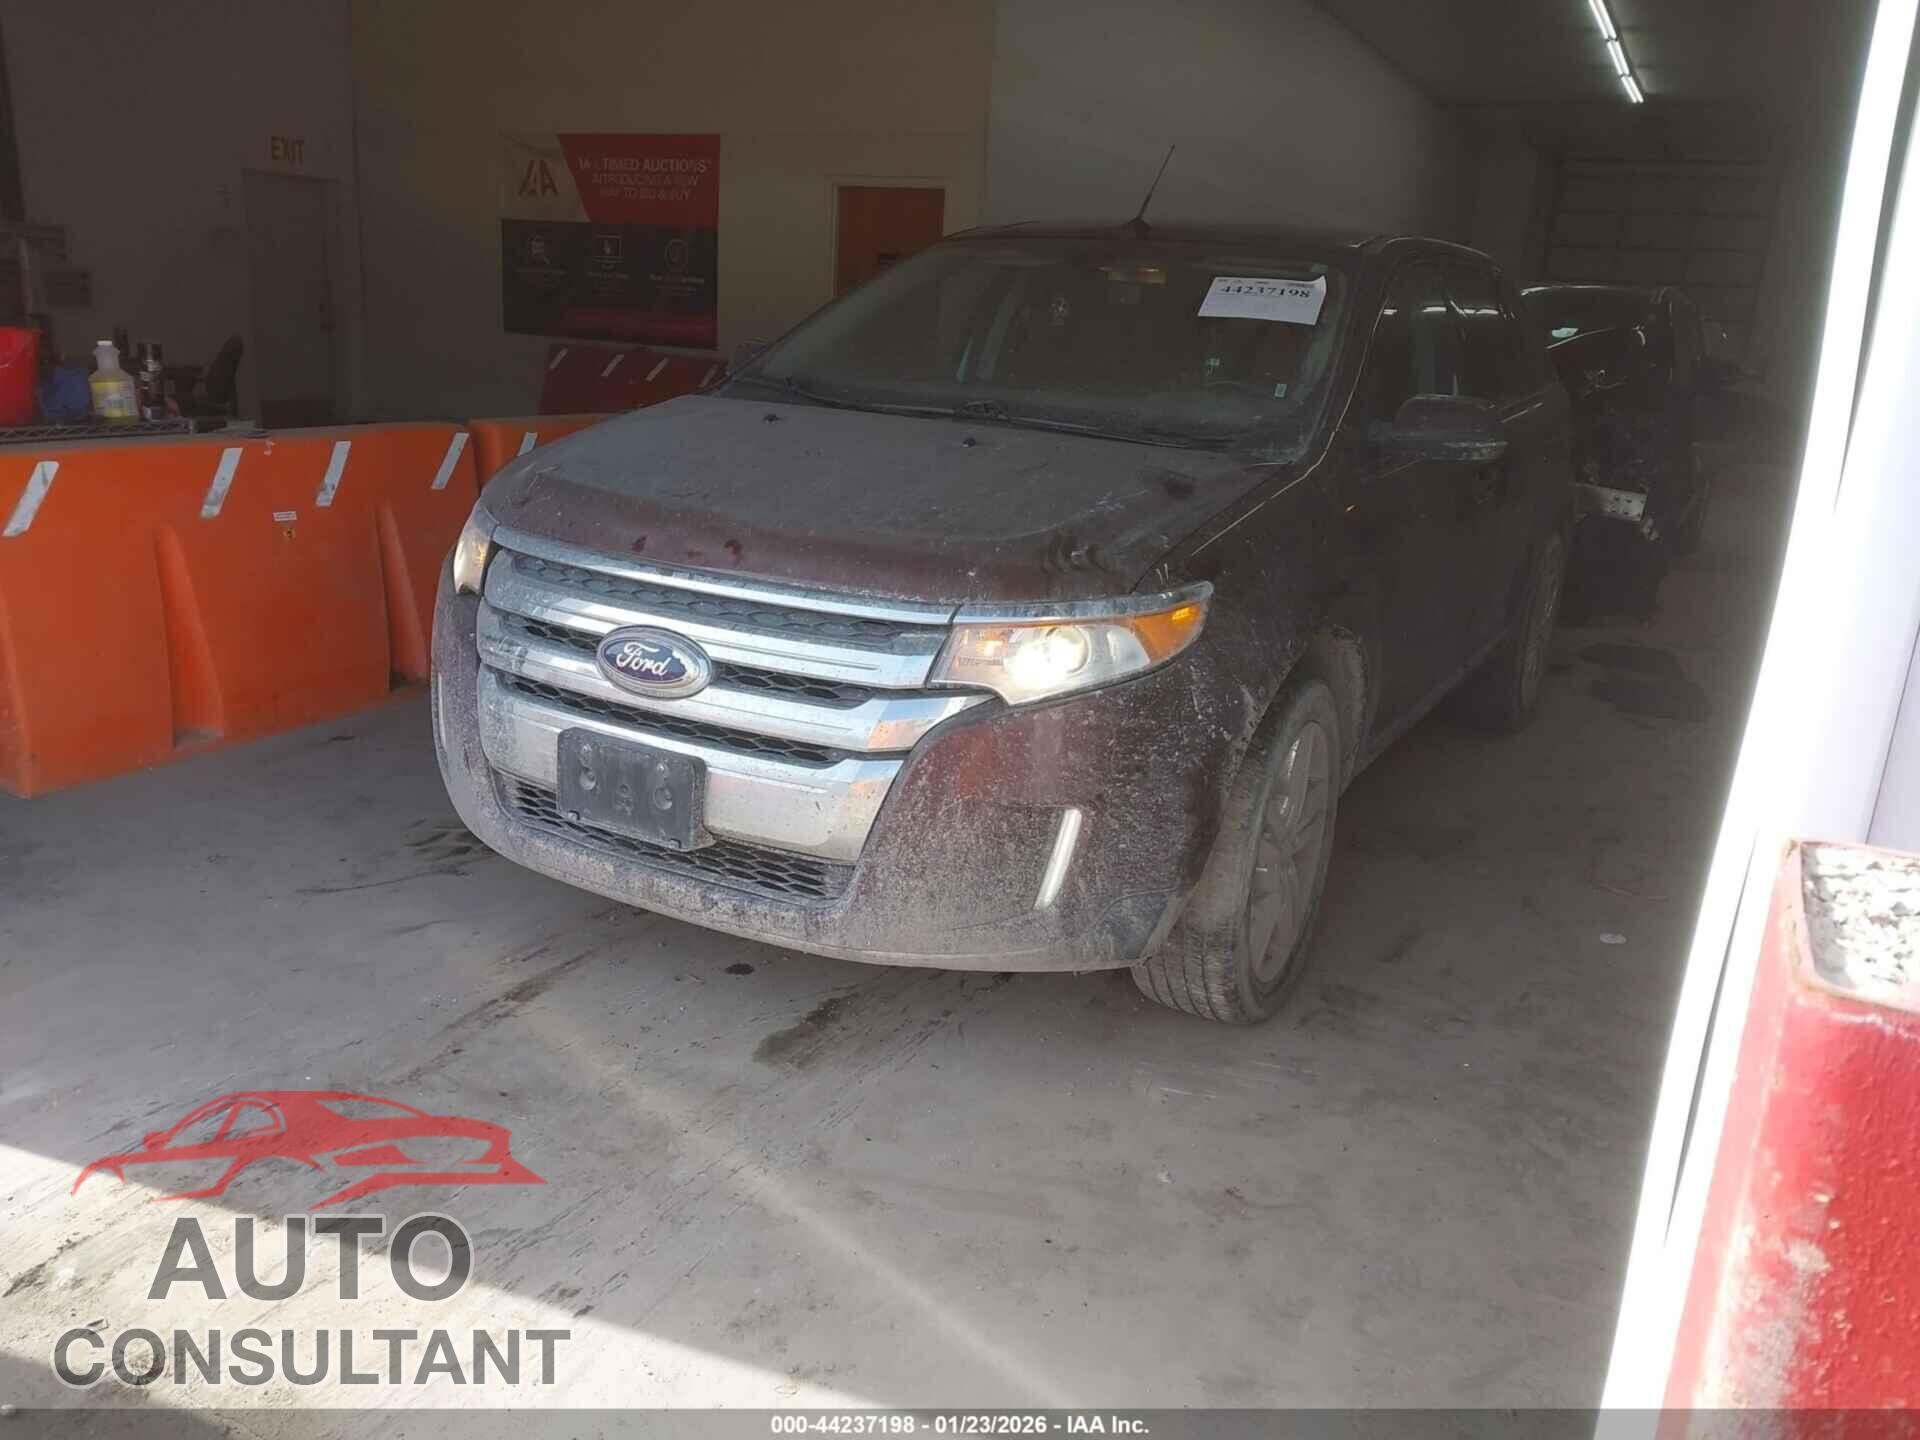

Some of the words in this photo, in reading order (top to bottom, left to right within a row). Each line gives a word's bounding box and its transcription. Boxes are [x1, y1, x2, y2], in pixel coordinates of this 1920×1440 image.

[271, 135, 304, 164] EXIT
[1221, 285, 1311, 299] 44237198
[616, 641, 671, 676] Ford
